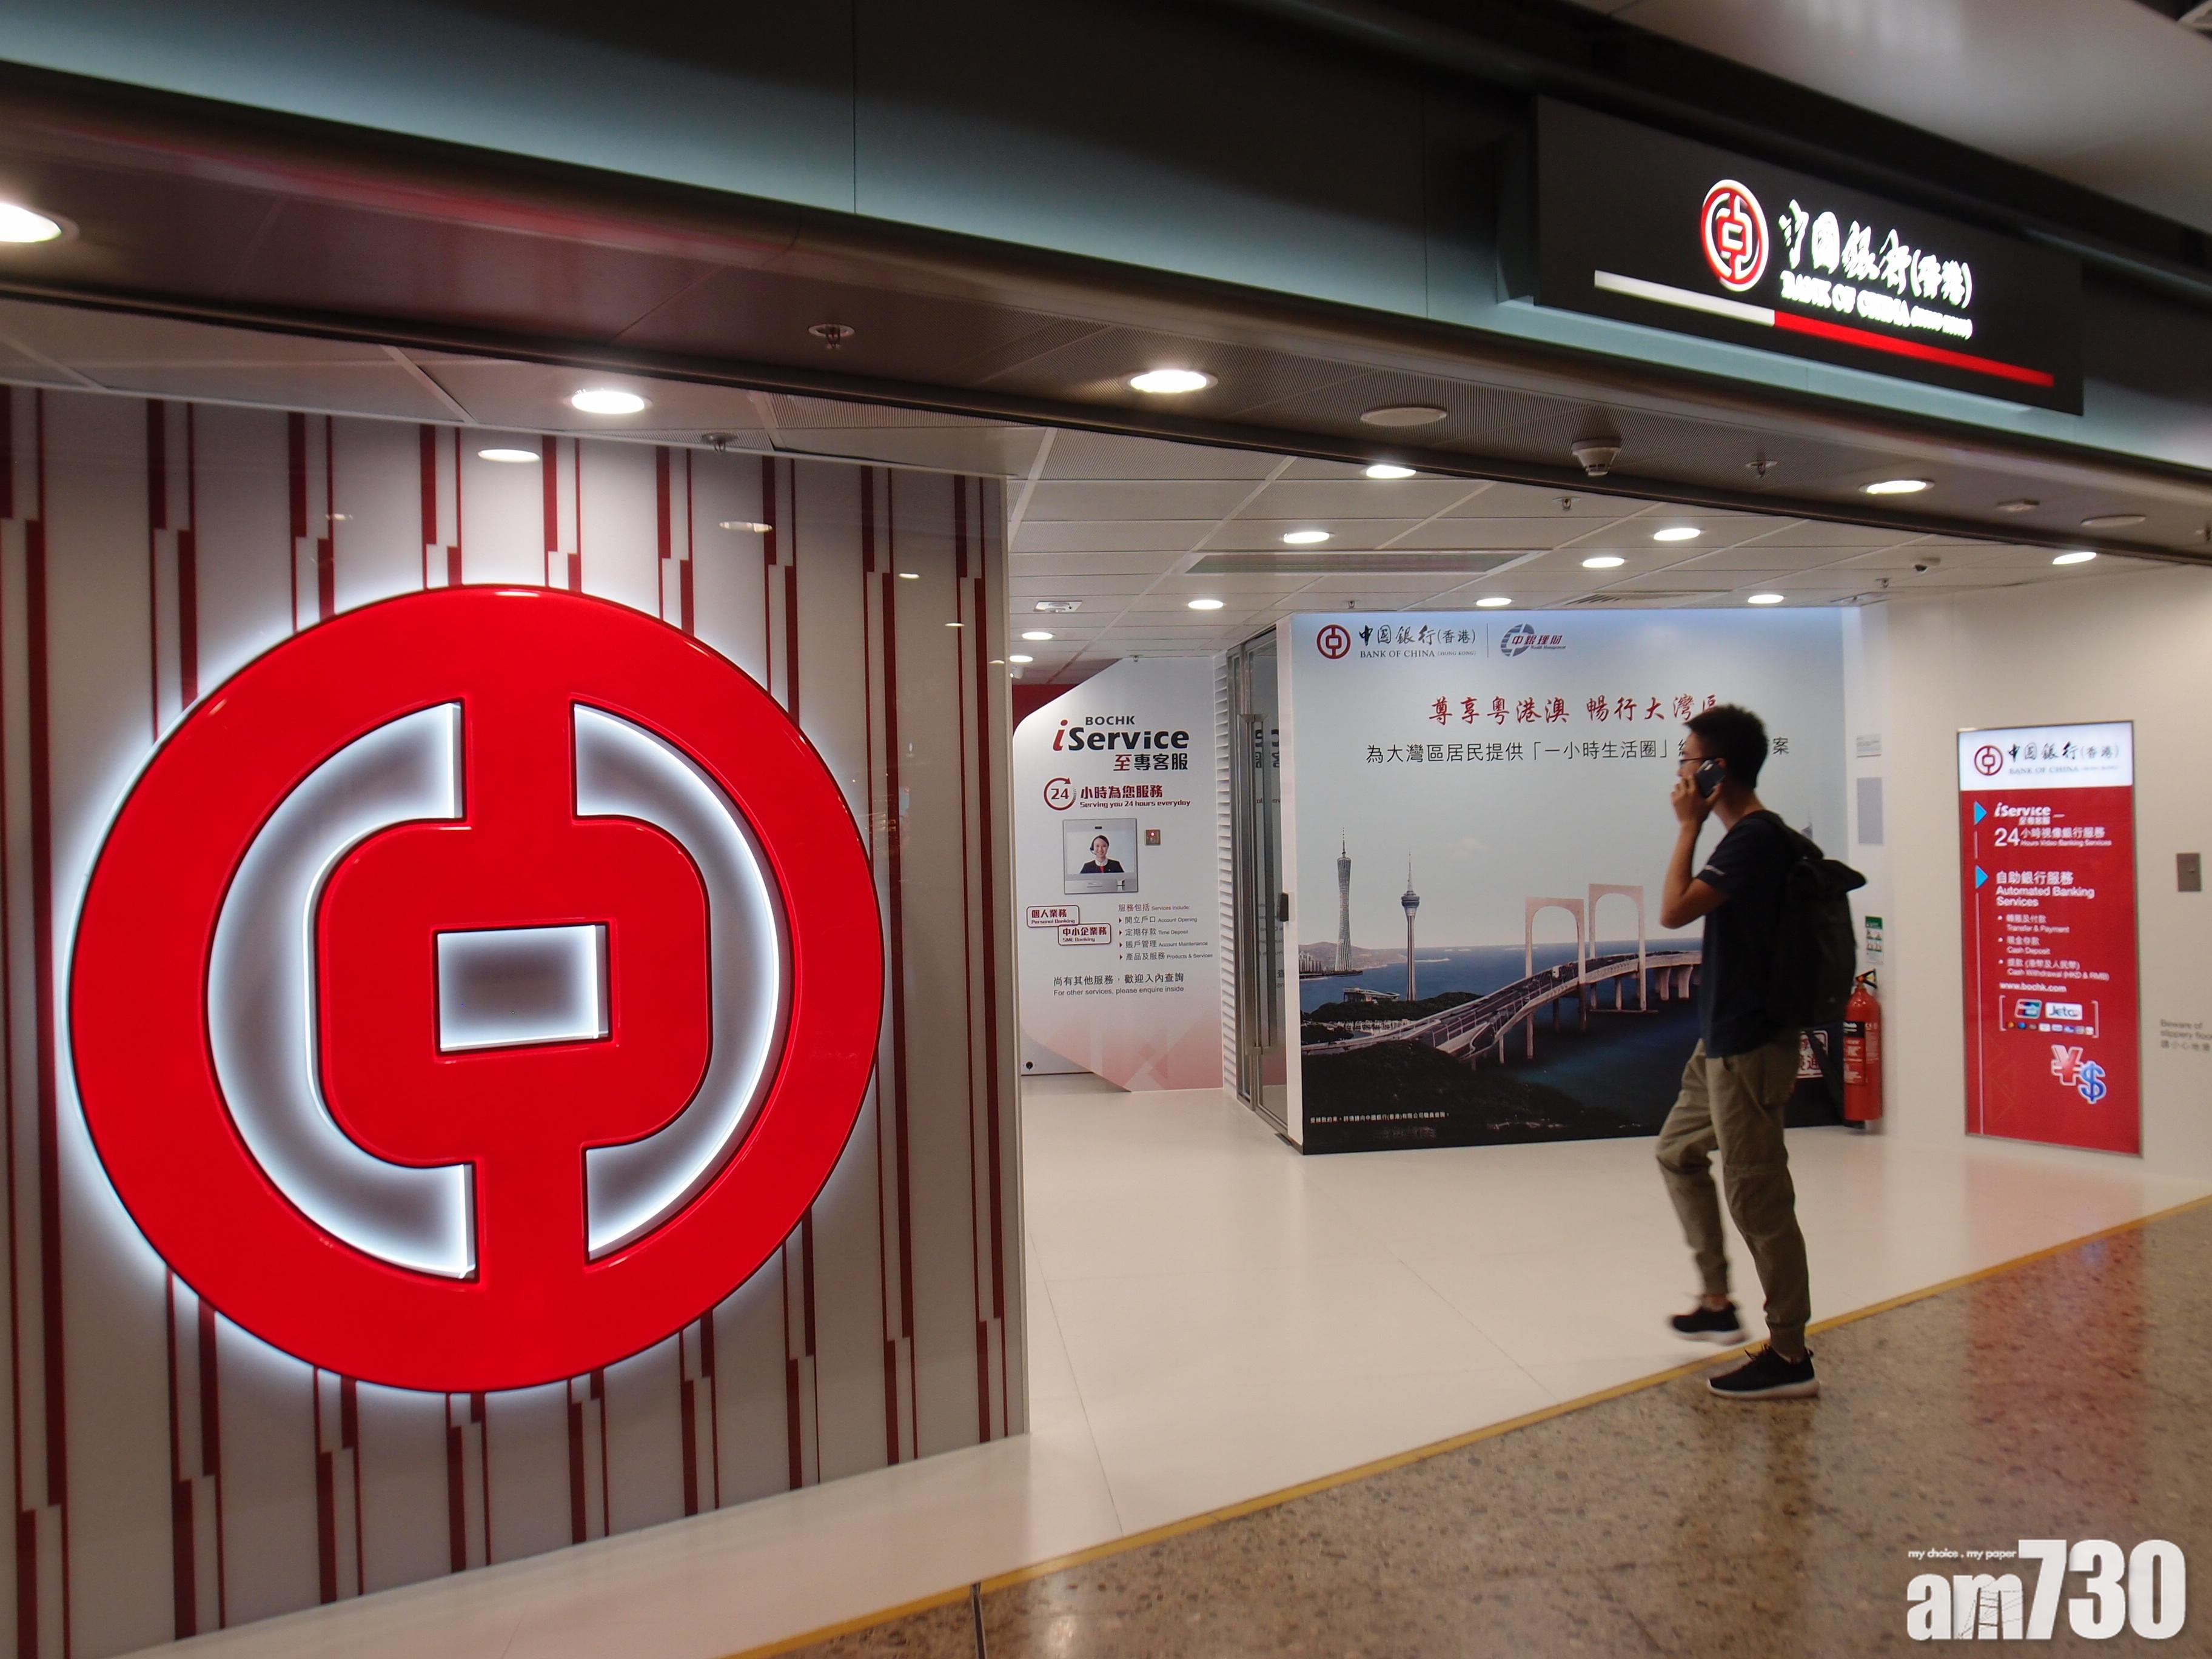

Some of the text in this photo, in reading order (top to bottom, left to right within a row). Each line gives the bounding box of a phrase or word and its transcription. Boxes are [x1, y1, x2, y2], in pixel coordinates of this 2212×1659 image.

[1085, 716, 1135, 726] BOCHK
[1053, 719, 1189, 751] iService
[1113, 753, 1188, 771] 至專客服
[1051, 785, 1163, 800] 24 小時為您服務
[1994, 802, 2051, 817] iService
[1994, 827, 2020, 846] 24
[1996, 885, 2095, 899] Automated Banking
[1118, 903, 1150, 912] 服務包括
[1996, 896, 2039, 907] Services
[1031, 909, 1067, 918] 個人業務
[1062, 927, 1107, 936] 中小企業務
[1125, 928, 1157, 936] 定期存款
